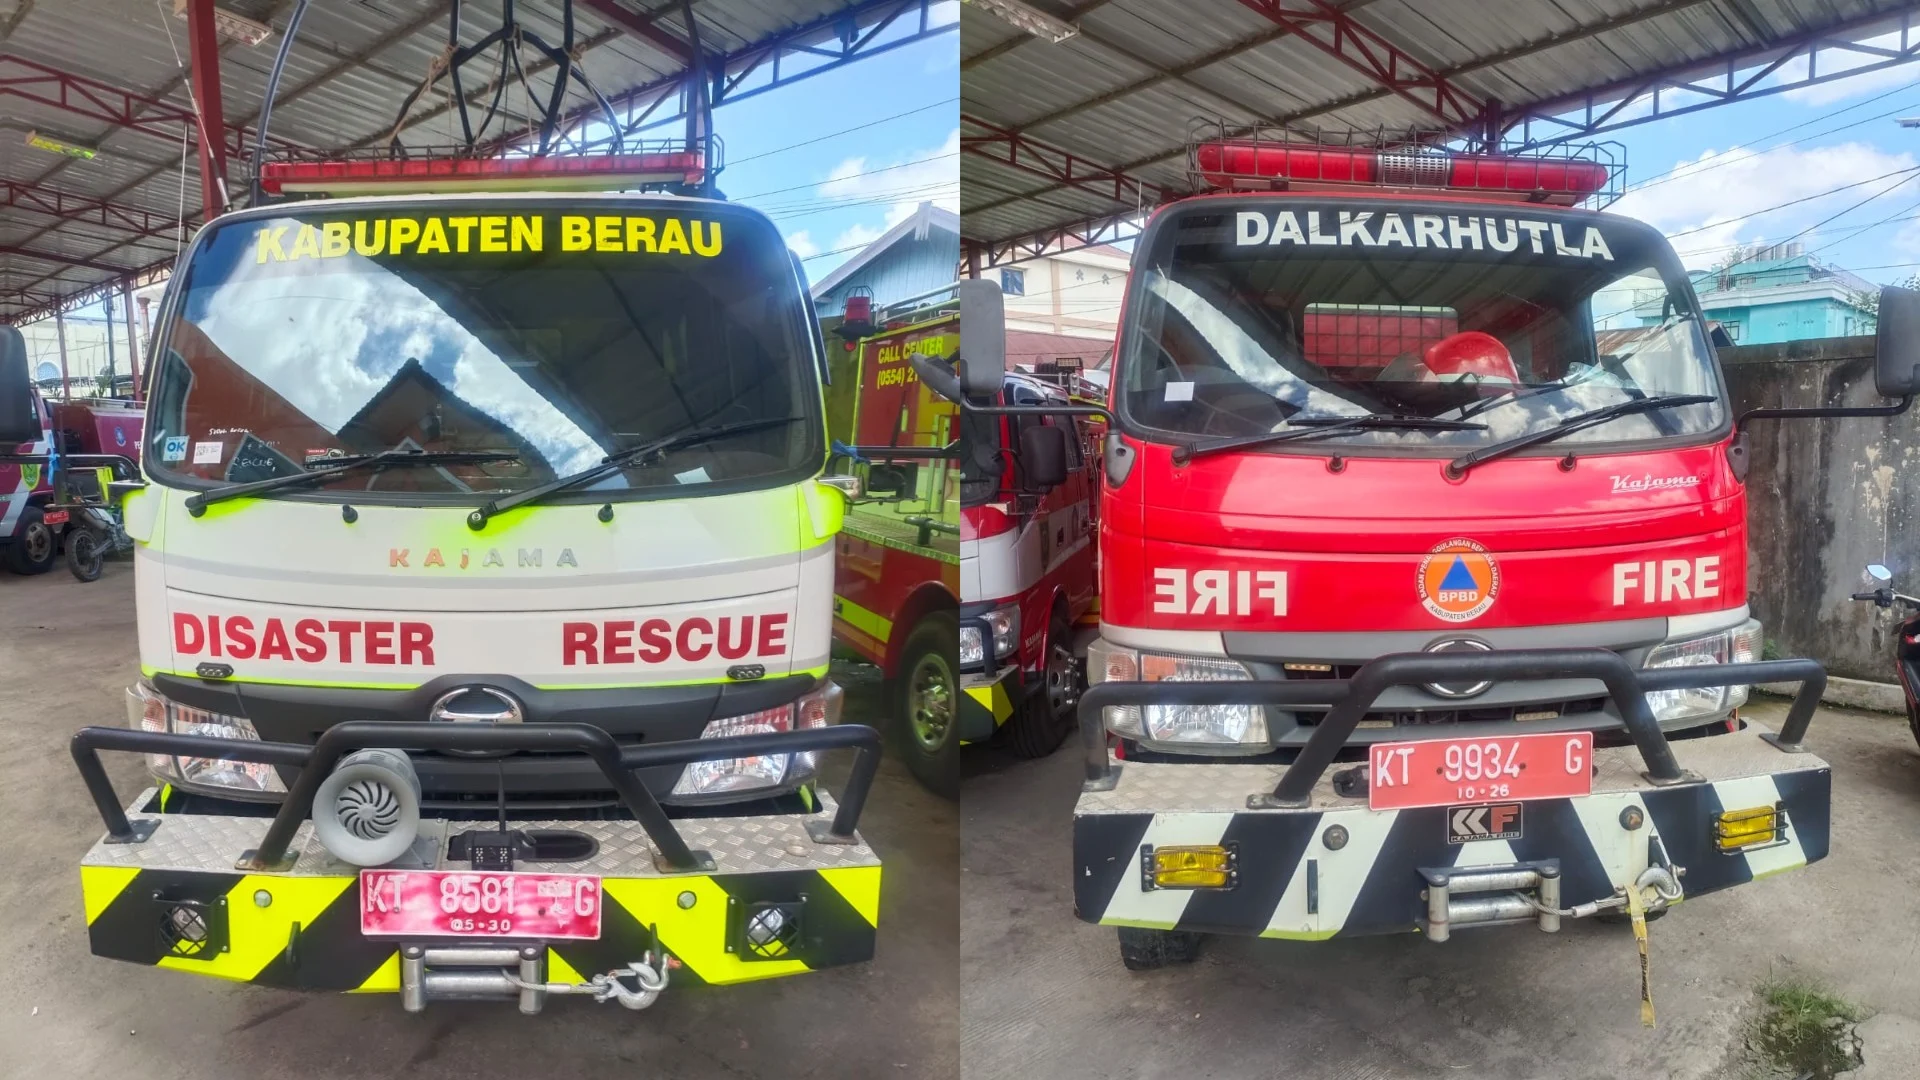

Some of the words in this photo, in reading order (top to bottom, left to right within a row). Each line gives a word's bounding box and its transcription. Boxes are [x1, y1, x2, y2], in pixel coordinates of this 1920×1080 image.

[256, 215, 544, 264] KABUPATEN
[562, 215, 723, 257] BERAU
[1236, 211, 1615, 261] DALKARHUTLA
[878, 345, 900, 365] CALL
[903, 336, 943, 360] CENTER
[877, 367, 905, 390] (0554)
[167, 442, 186, 453] OK
[1609, 472, 1700, 492] Kajama
[389, 548, 578, 569] KAJAMA
[1613, 555, 1720, 606] FIRE
[1438, 591, 1478, 602] BPBD
[1429, 603, 1466, 620] KABUPATEN
[1466, 602, 1487, 618] BERAU
[173, 612, 435, 666] DISASTER
[562, 613, 789, 666] RESCUE
[1376, 747, 1415, 788] KT
[1445, 741, 1520, 782] 9934
[1565, 738, 1583, 775] G
[1451, 832, 1494, 842] KAJAMA
[1496, 831, 1519, 839] FIRE
[366, 874, 407, 914] KT
[439, 875, 516, 915] 8581
[574, 878, 595, 917] G
